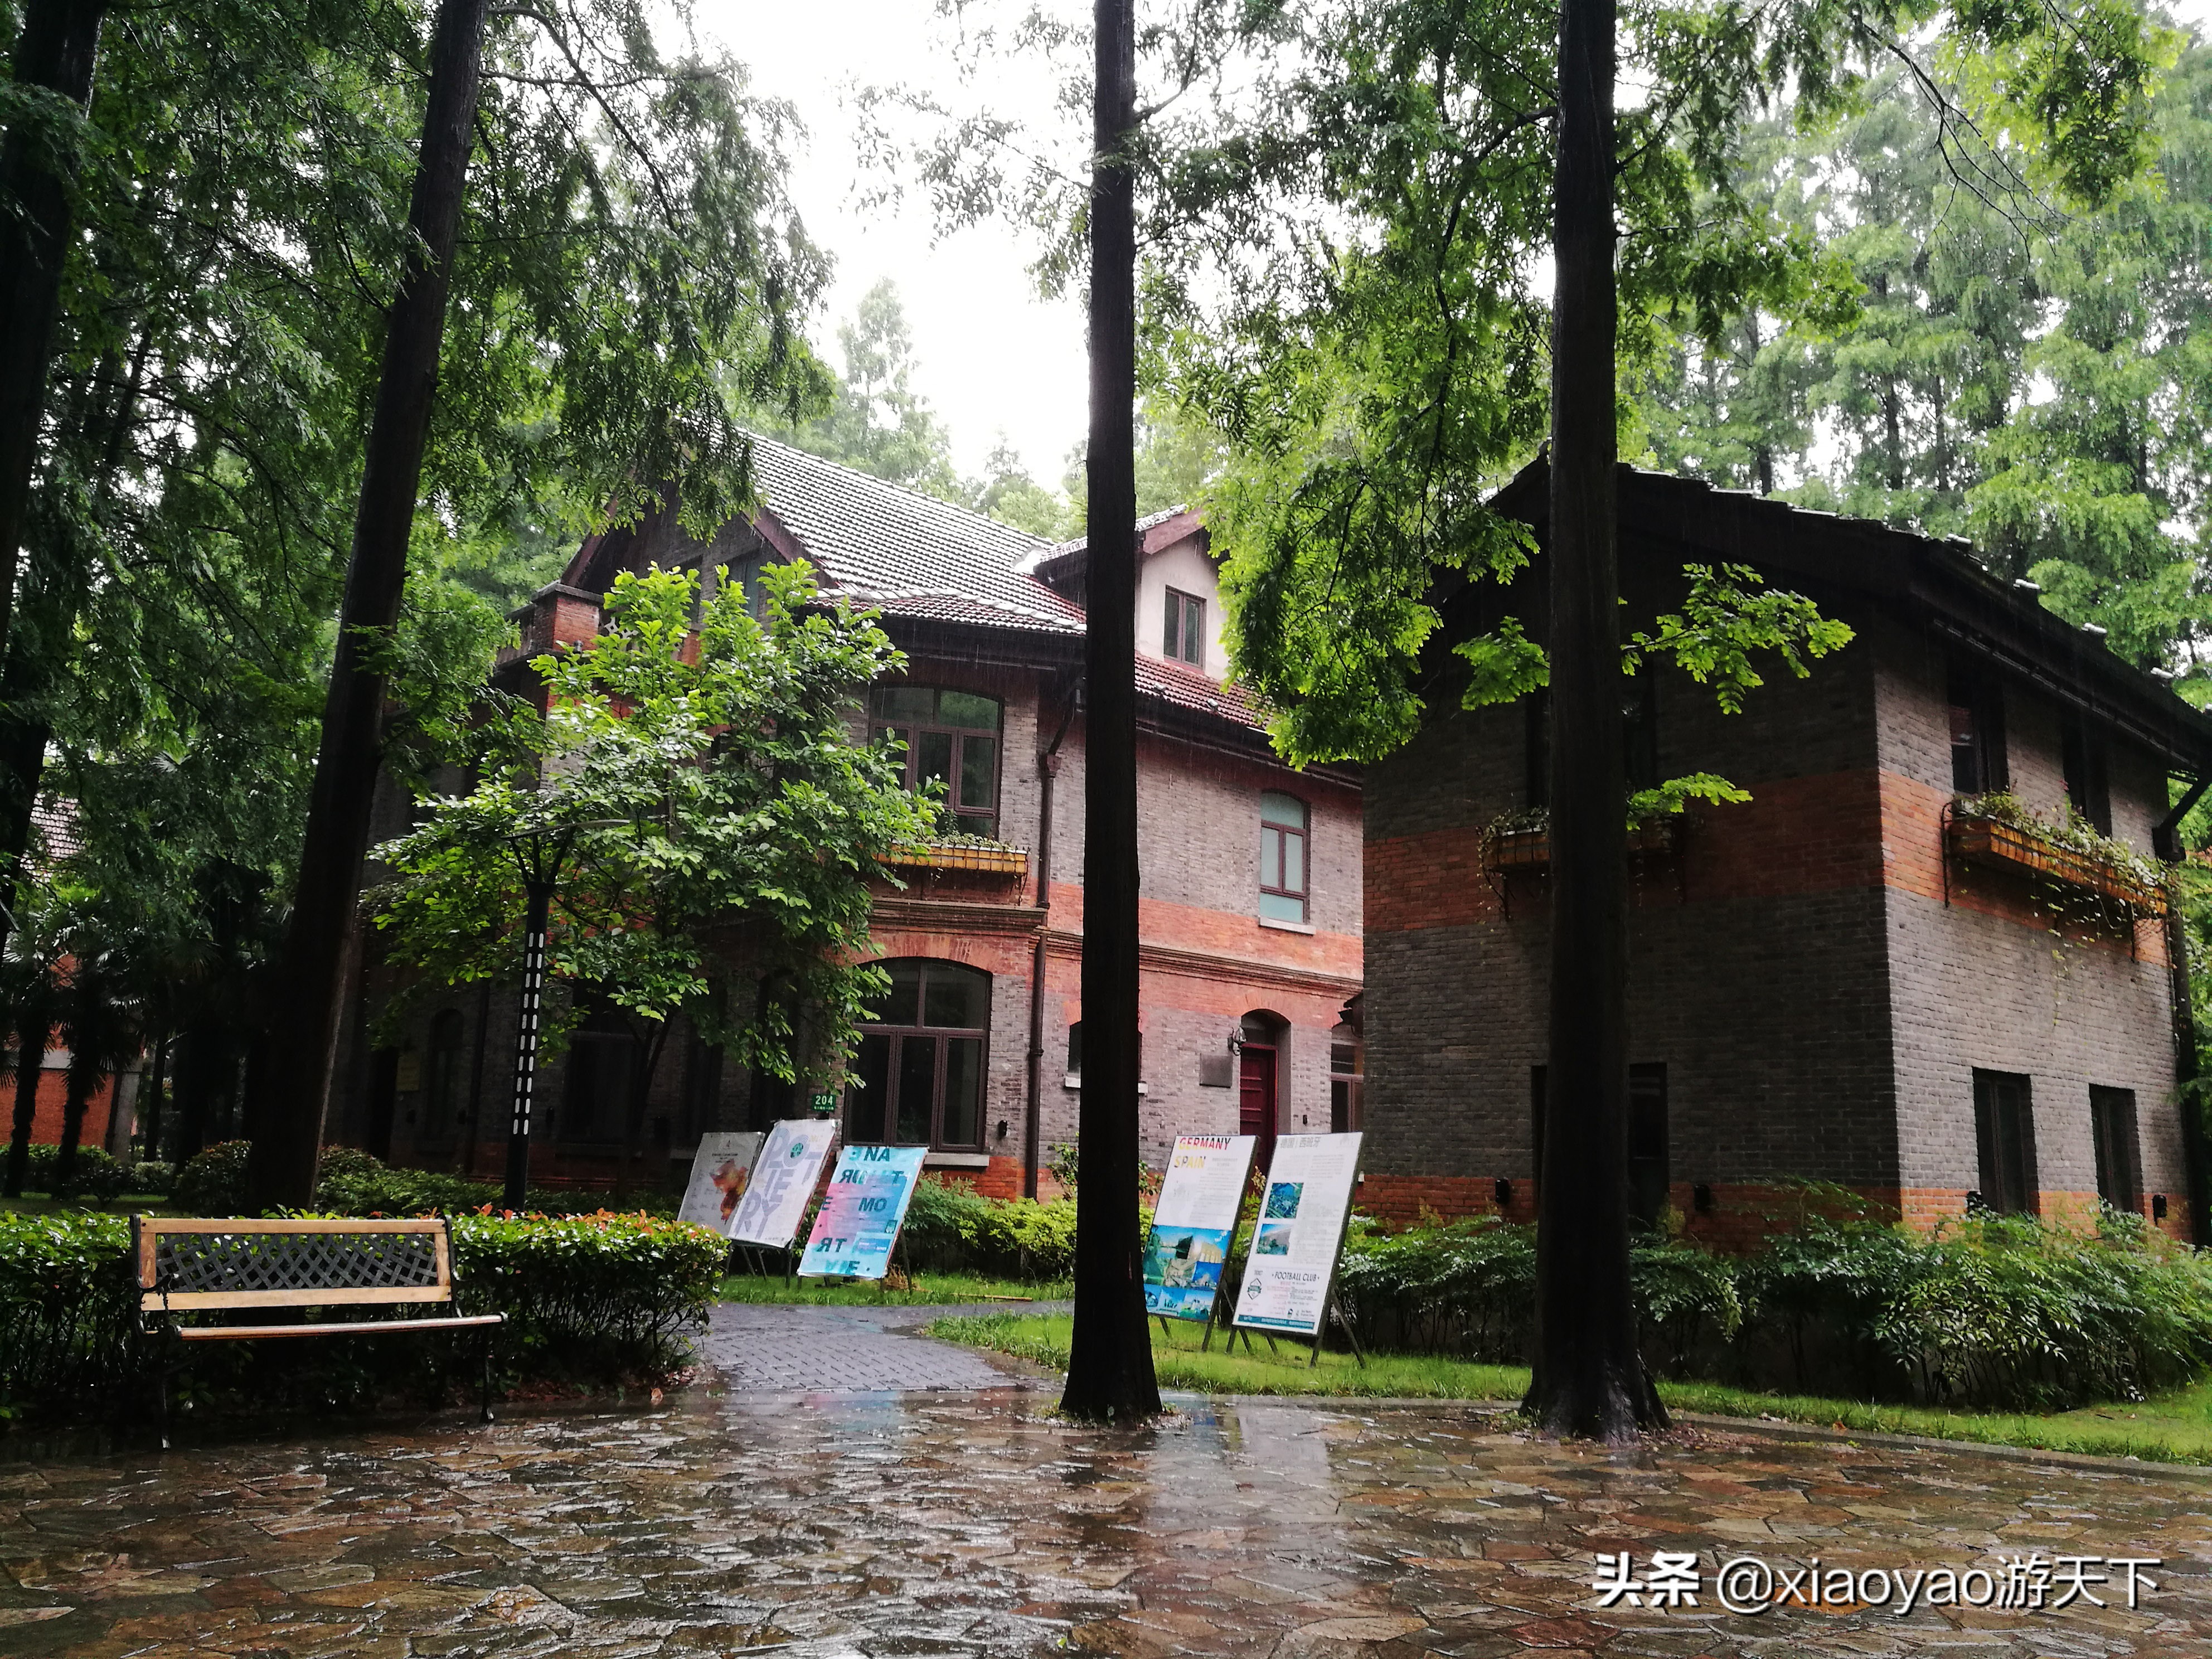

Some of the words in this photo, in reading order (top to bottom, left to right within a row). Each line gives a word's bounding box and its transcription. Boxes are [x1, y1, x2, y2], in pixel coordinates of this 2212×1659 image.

[816, 1095, 833, 1105] 204
[1179, 1137, 1231, 1150] GERMANY
[1174, 1156, 1206, 1168] SPAIN
[858, 1197, 887, 1212] MO
[1275, 1272, 1301, 1281] FOOTBALL
[1302, 1273, 1317, 1282] CLUB
